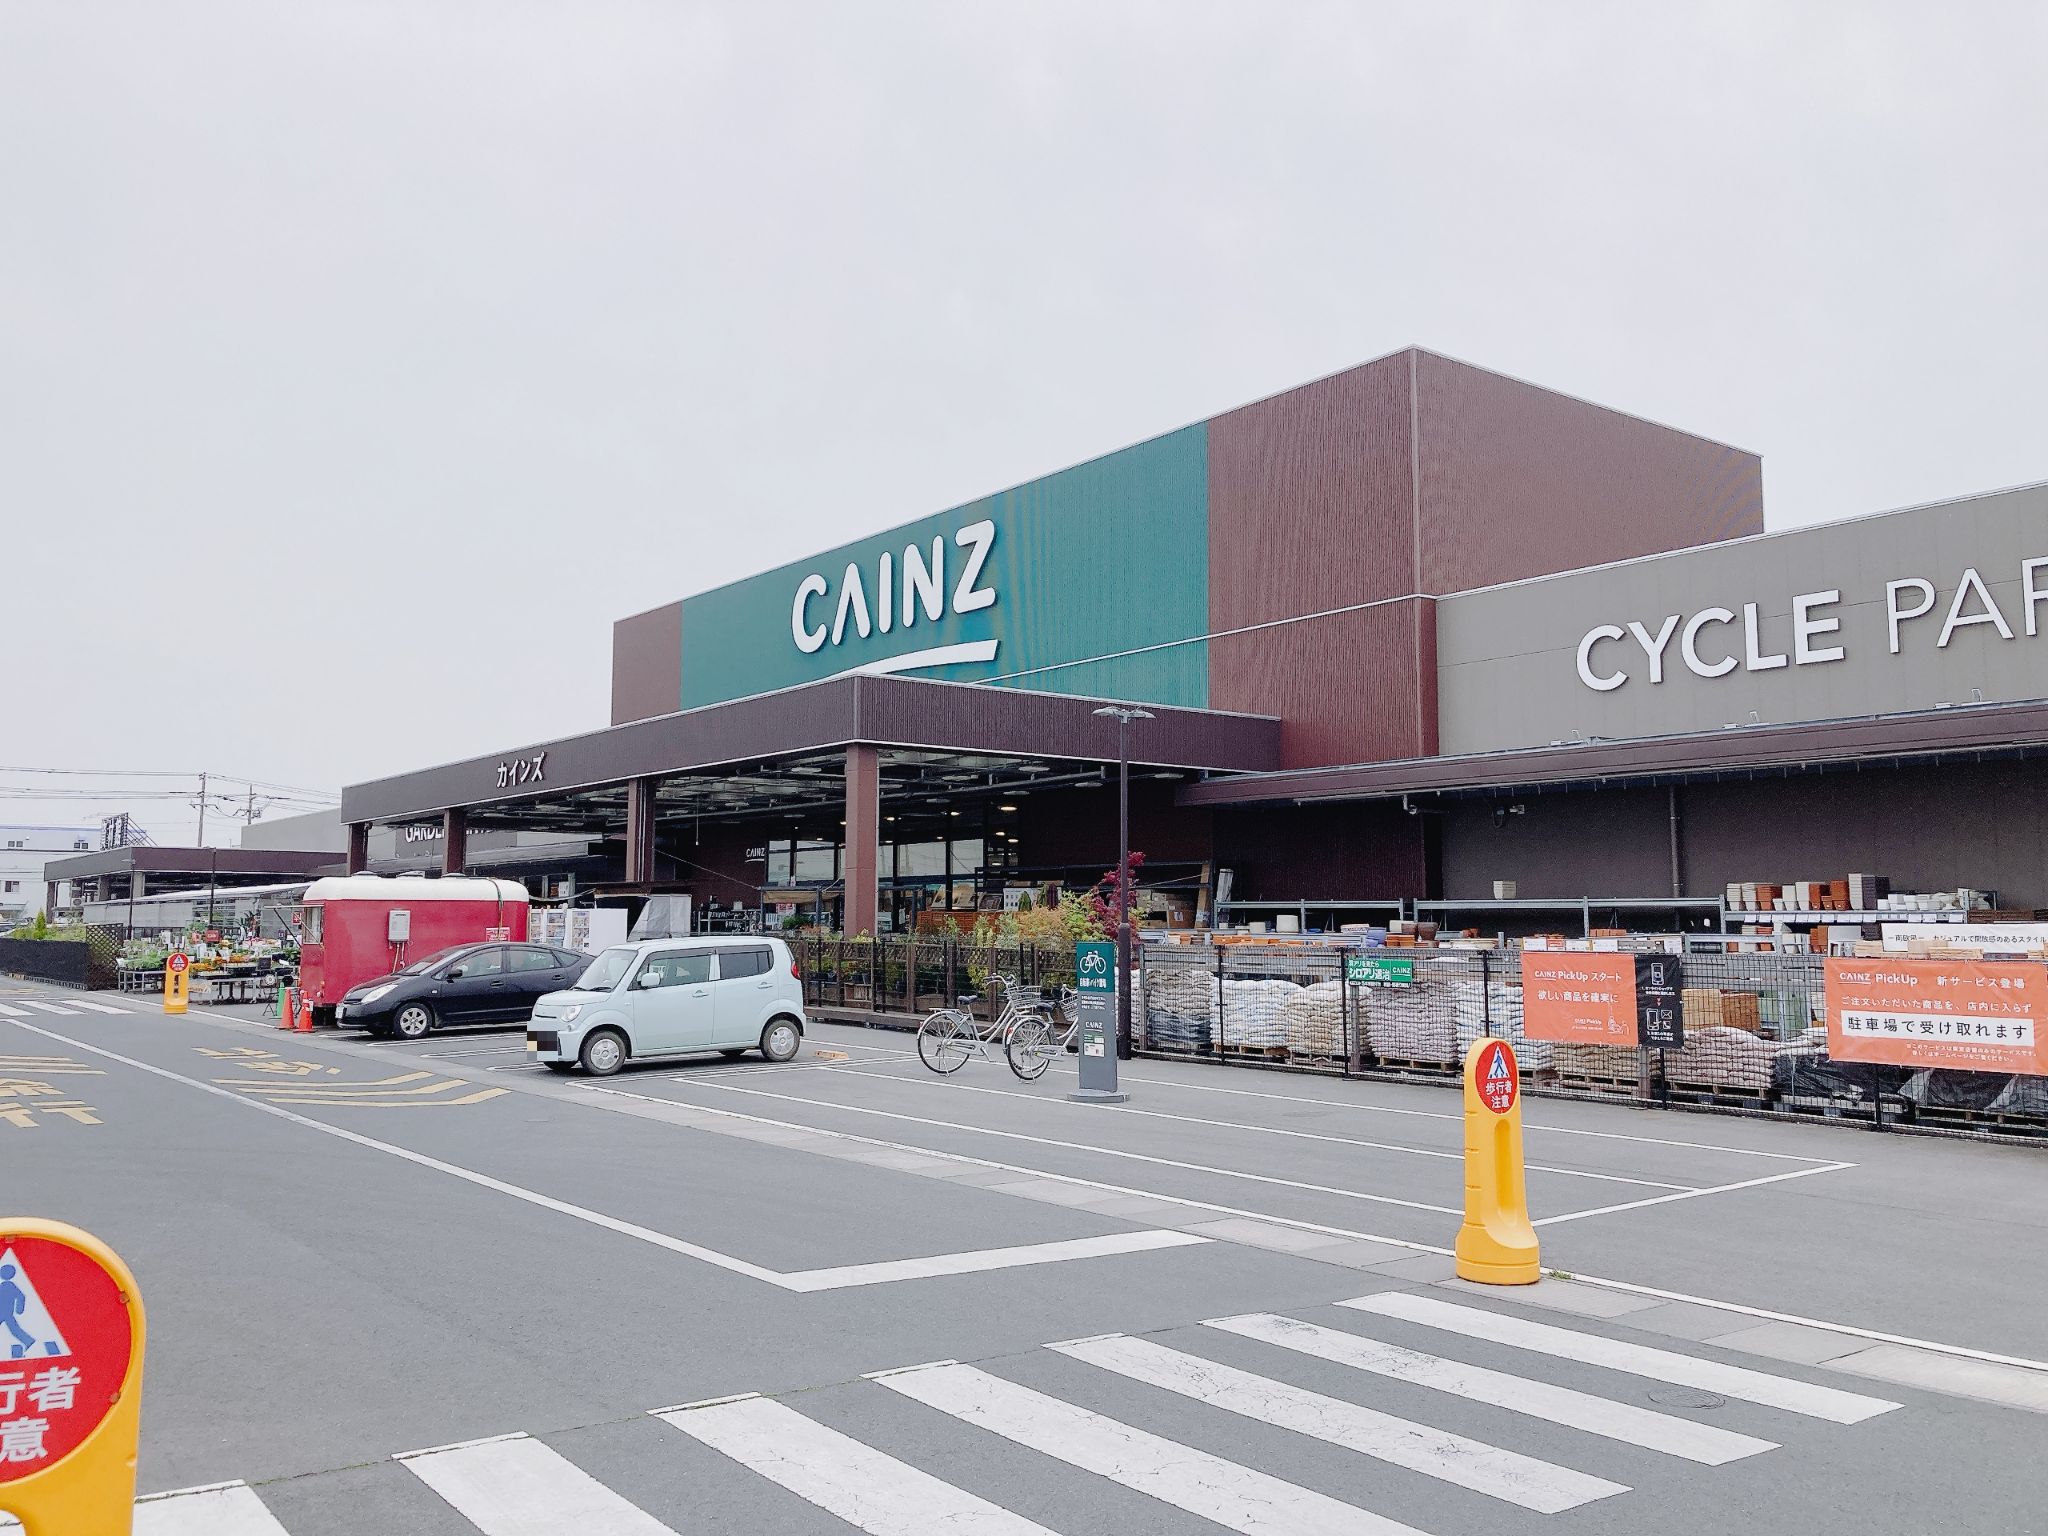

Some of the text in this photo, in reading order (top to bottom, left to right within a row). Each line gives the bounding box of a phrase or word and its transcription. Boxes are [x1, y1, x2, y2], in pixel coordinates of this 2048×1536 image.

[792, 519, 996, 654] CAINZ
[1576, 589, 1845, 692] CYCLE
[496, 751, 546, 788] カインズ
[745, 847, 766, 858] CAINZ
[1392, 966, 1411, 974] CAINZ
[1534, 970, 1622, 983] CAINZ PickUp スタート
[1839, 972, 2026, 990] CAINZ PickUp 新サービス登場
[1537, 989, 1620, 1004] 欲しい商品を確実に
[1847, 1016, 2027, 1040] 駐車場で受け取れます
[1486, 1080, 1512, 1095] 歩行者
[1491, 1095, 1510, 1109] 注意
